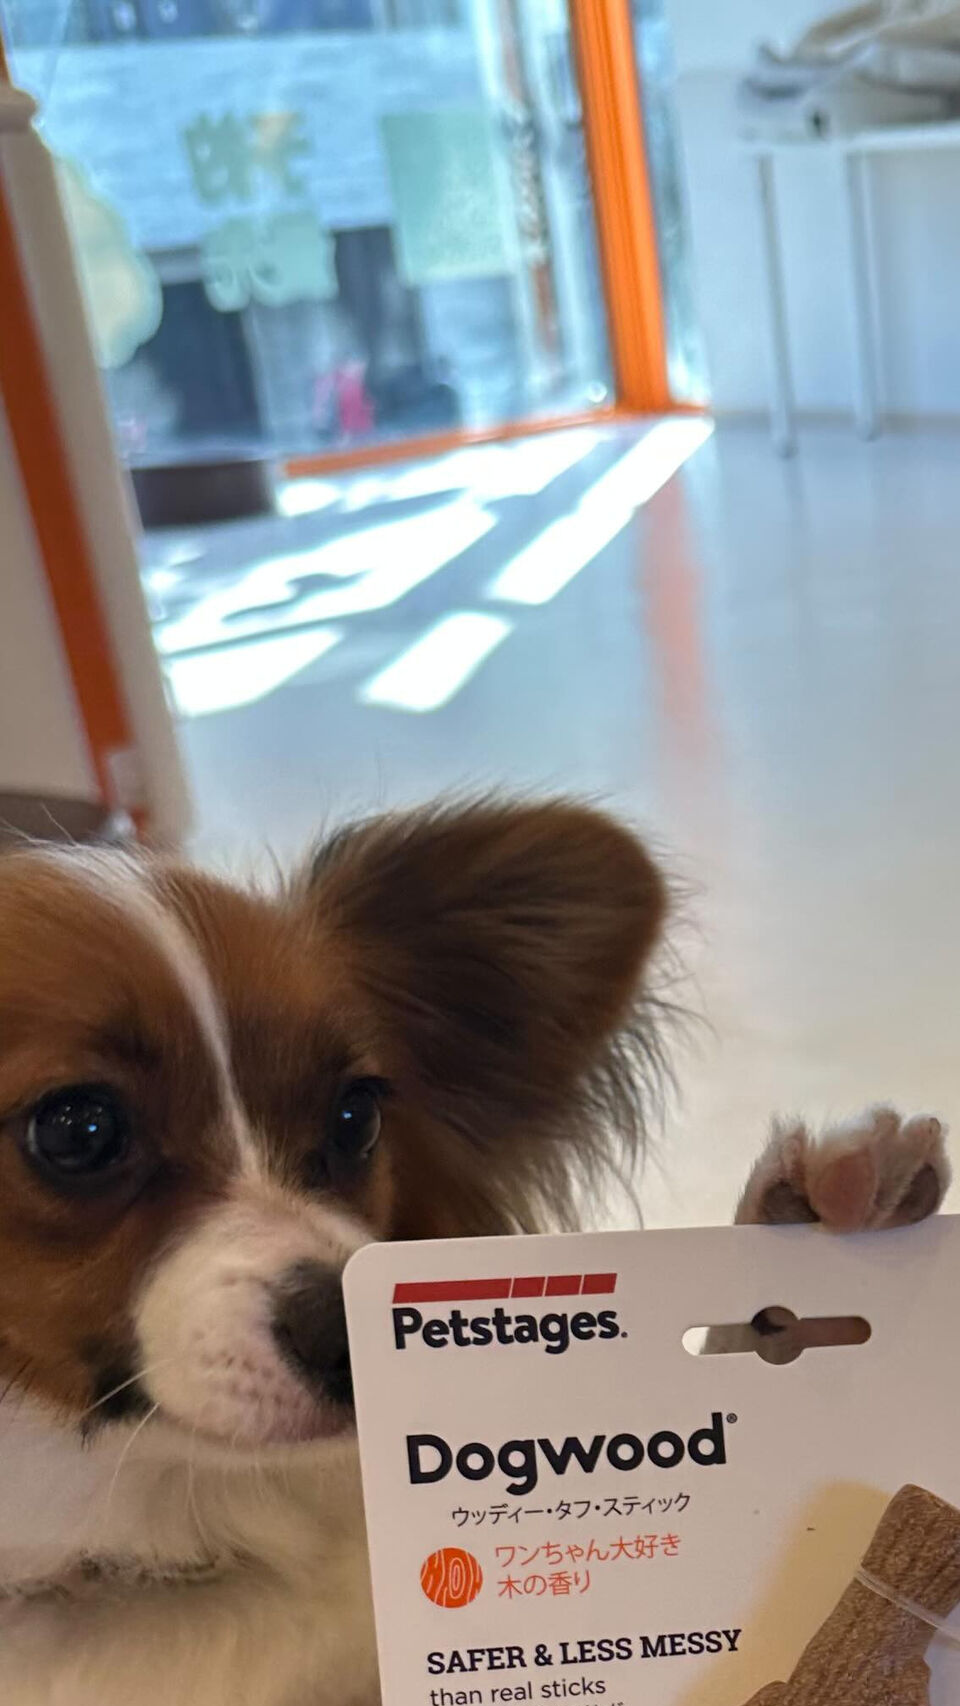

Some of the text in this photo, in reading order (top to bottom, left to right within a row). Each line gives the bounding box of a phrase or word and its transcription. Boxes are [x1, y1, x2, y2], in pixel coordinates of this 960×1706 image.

[495, 1533, 681, 1568] ワンちゃん大好き
[497, 1570, 590, 1599] 木の香り
[427, 1629, 742, 1675] SAFER & LESS MESSY
[430, 1677, 606, 1706] than real sticks
